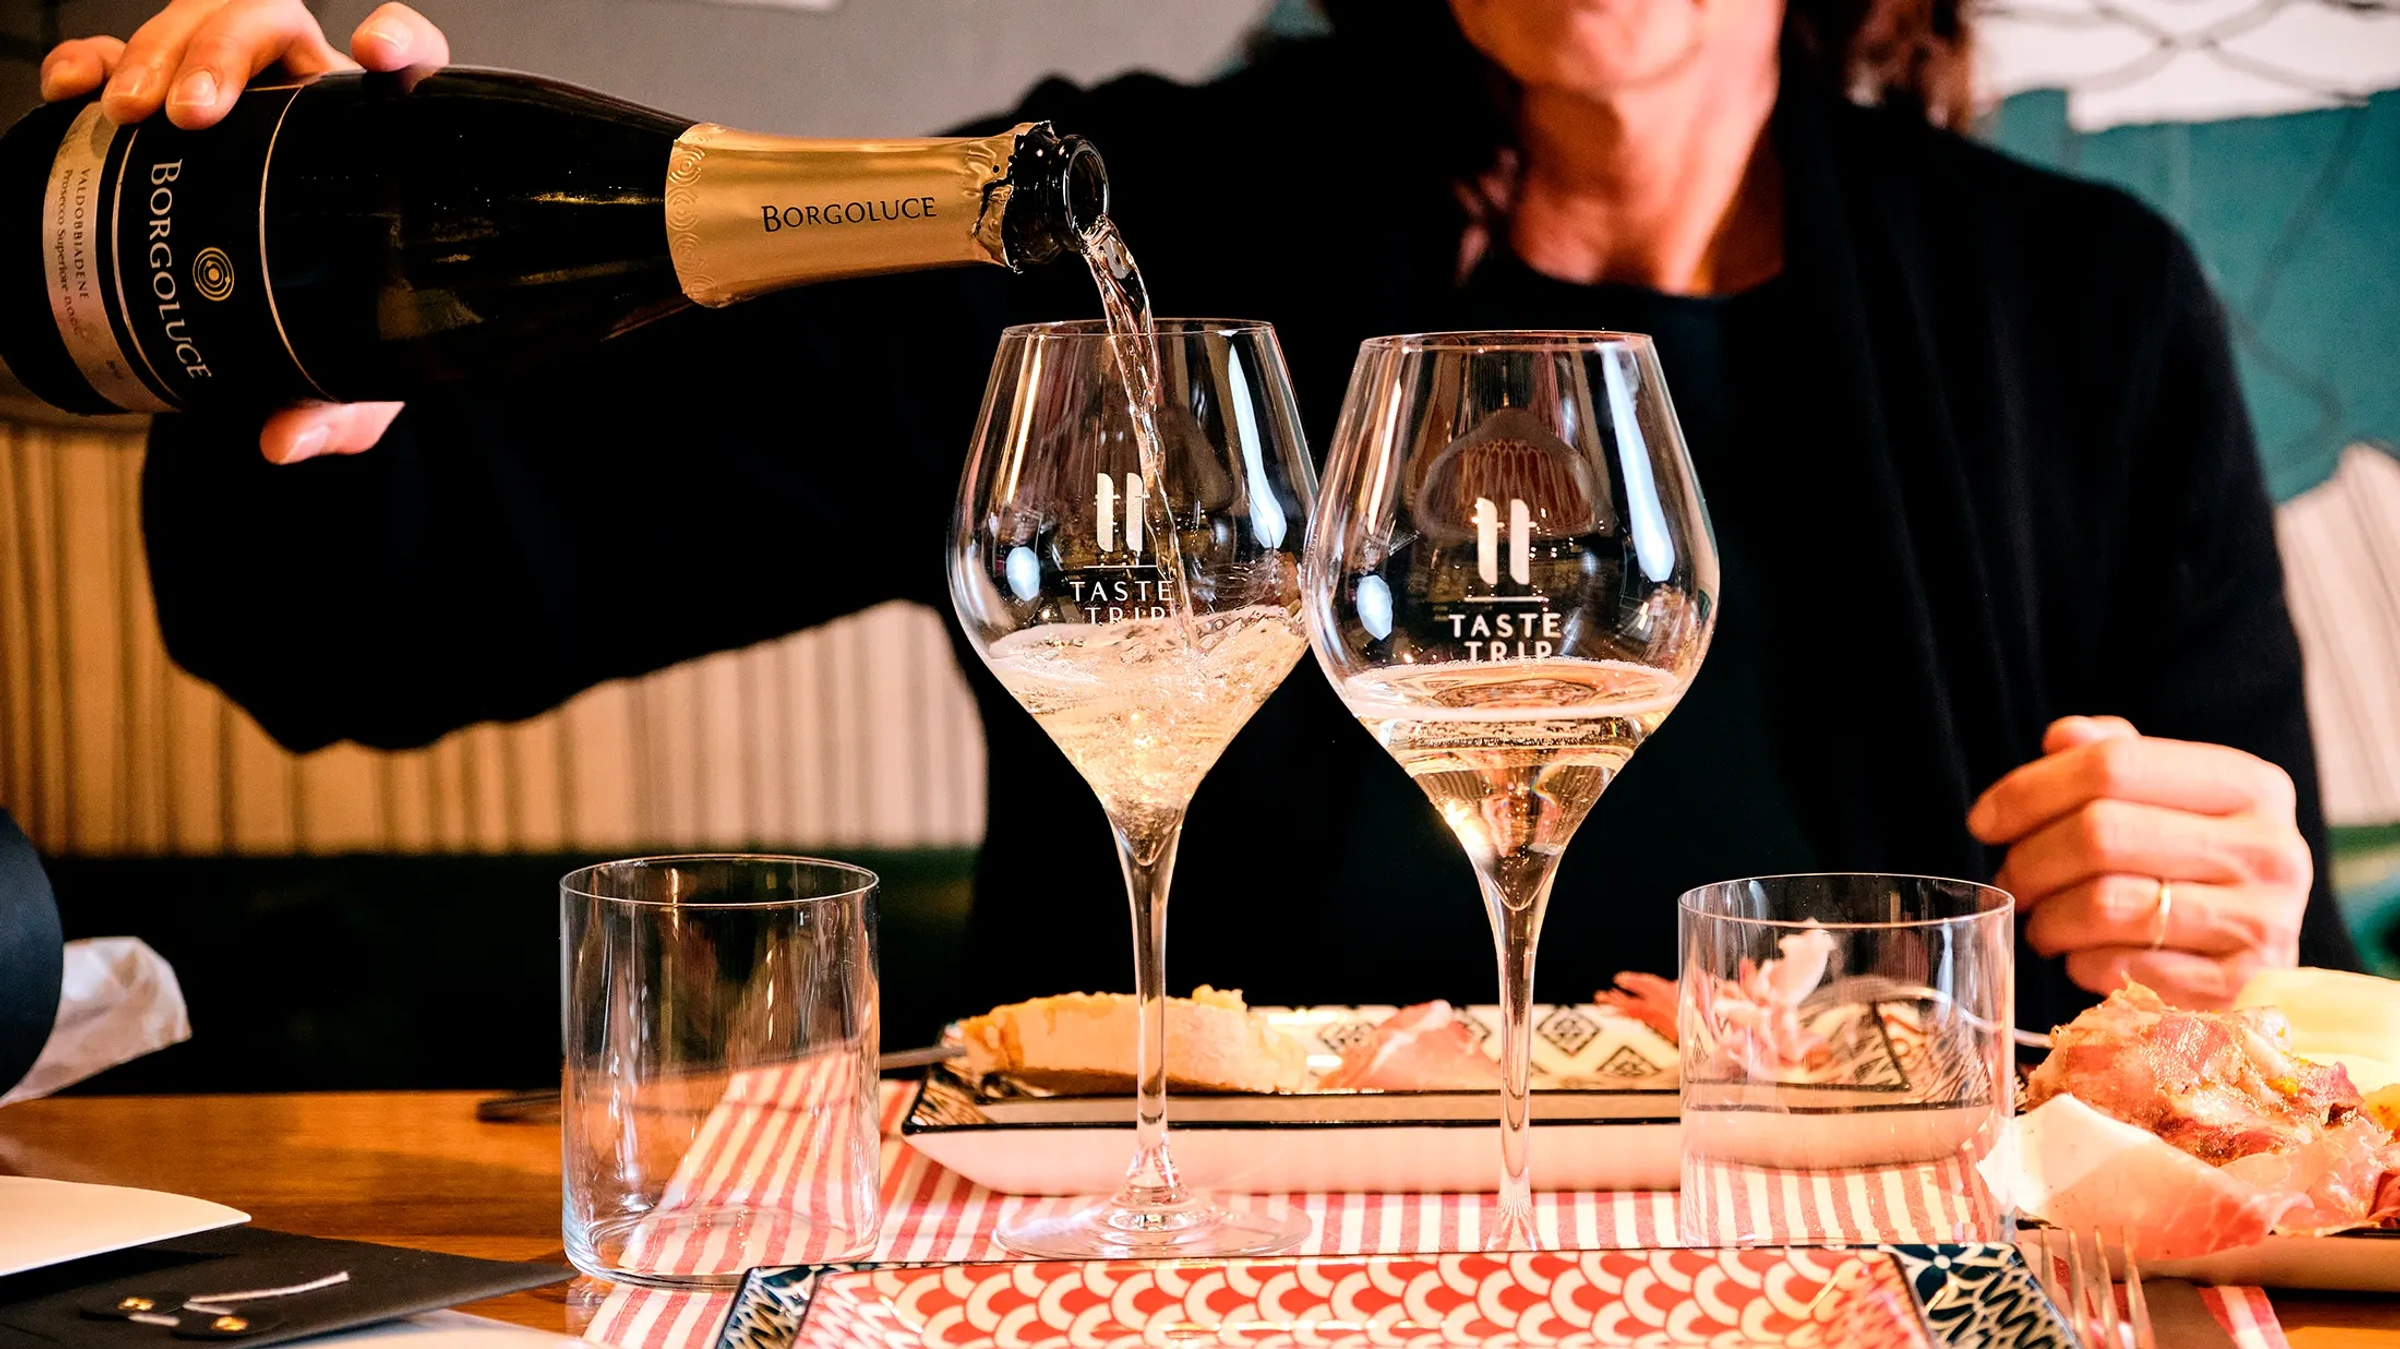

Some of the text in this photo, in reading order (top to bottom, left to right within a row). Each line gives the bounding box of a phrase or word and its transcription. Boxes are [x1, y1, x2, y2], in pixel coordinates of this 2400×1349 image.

[57, 169, 73, 225] Prosecco
[761, 196, 938, 233] BORGOLUCE
[73, 167, 91, 300] VALDOBBIADENE
[149, 158, 213, 379] BORGOLUCE
[1069, 580, 1174, 602] TASTE
[1448, 613, 1562, 638] TASTE
[1464, 641, 1553, 663] TRIP
